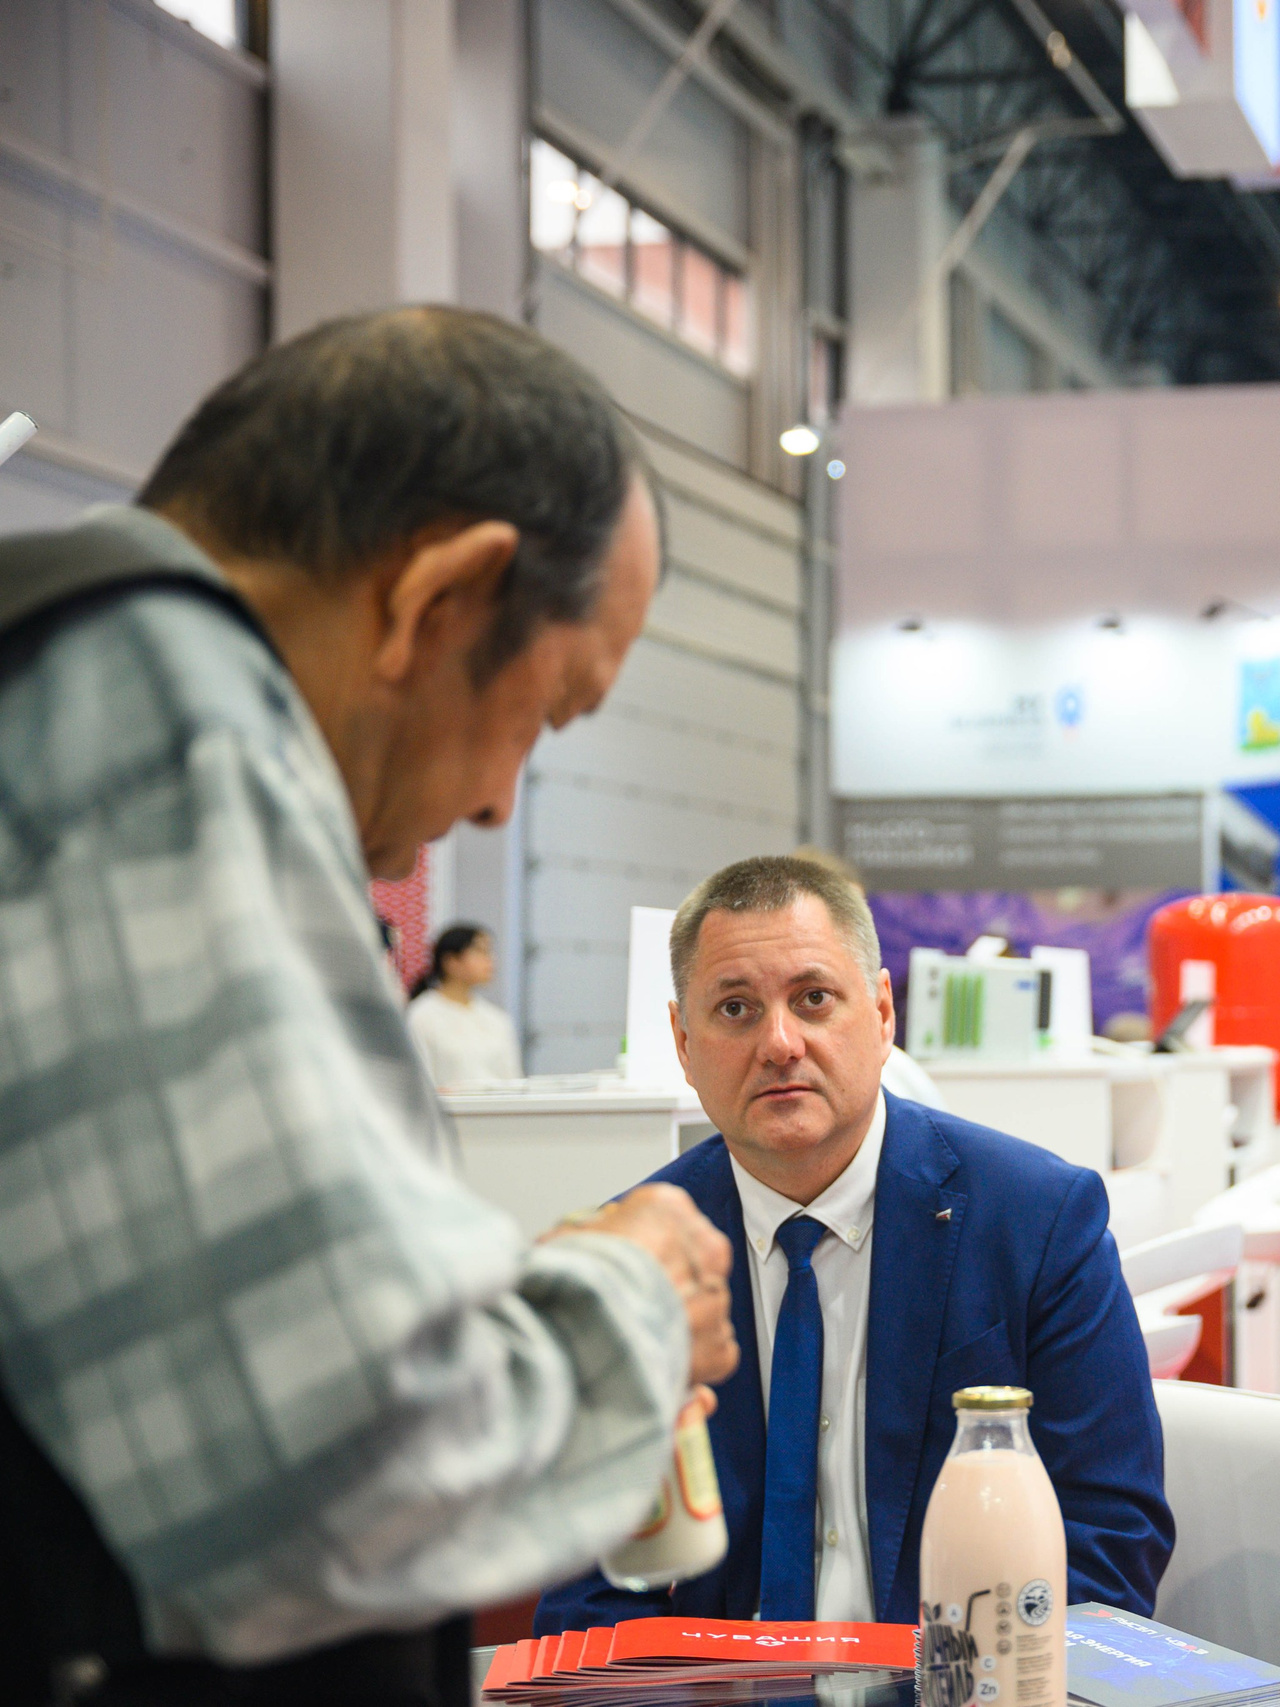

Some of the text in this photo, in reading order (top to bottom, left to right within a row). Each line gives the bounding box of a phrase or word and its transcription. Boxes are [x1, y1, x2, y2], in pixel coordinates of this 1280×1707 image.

[681, 1632, 860, 1643] ЧУВАШИЯ
[1080, 1638, 1153, 1668] ЭНЕРГИЯ
[980, 1683, 997, 1695] Zn
